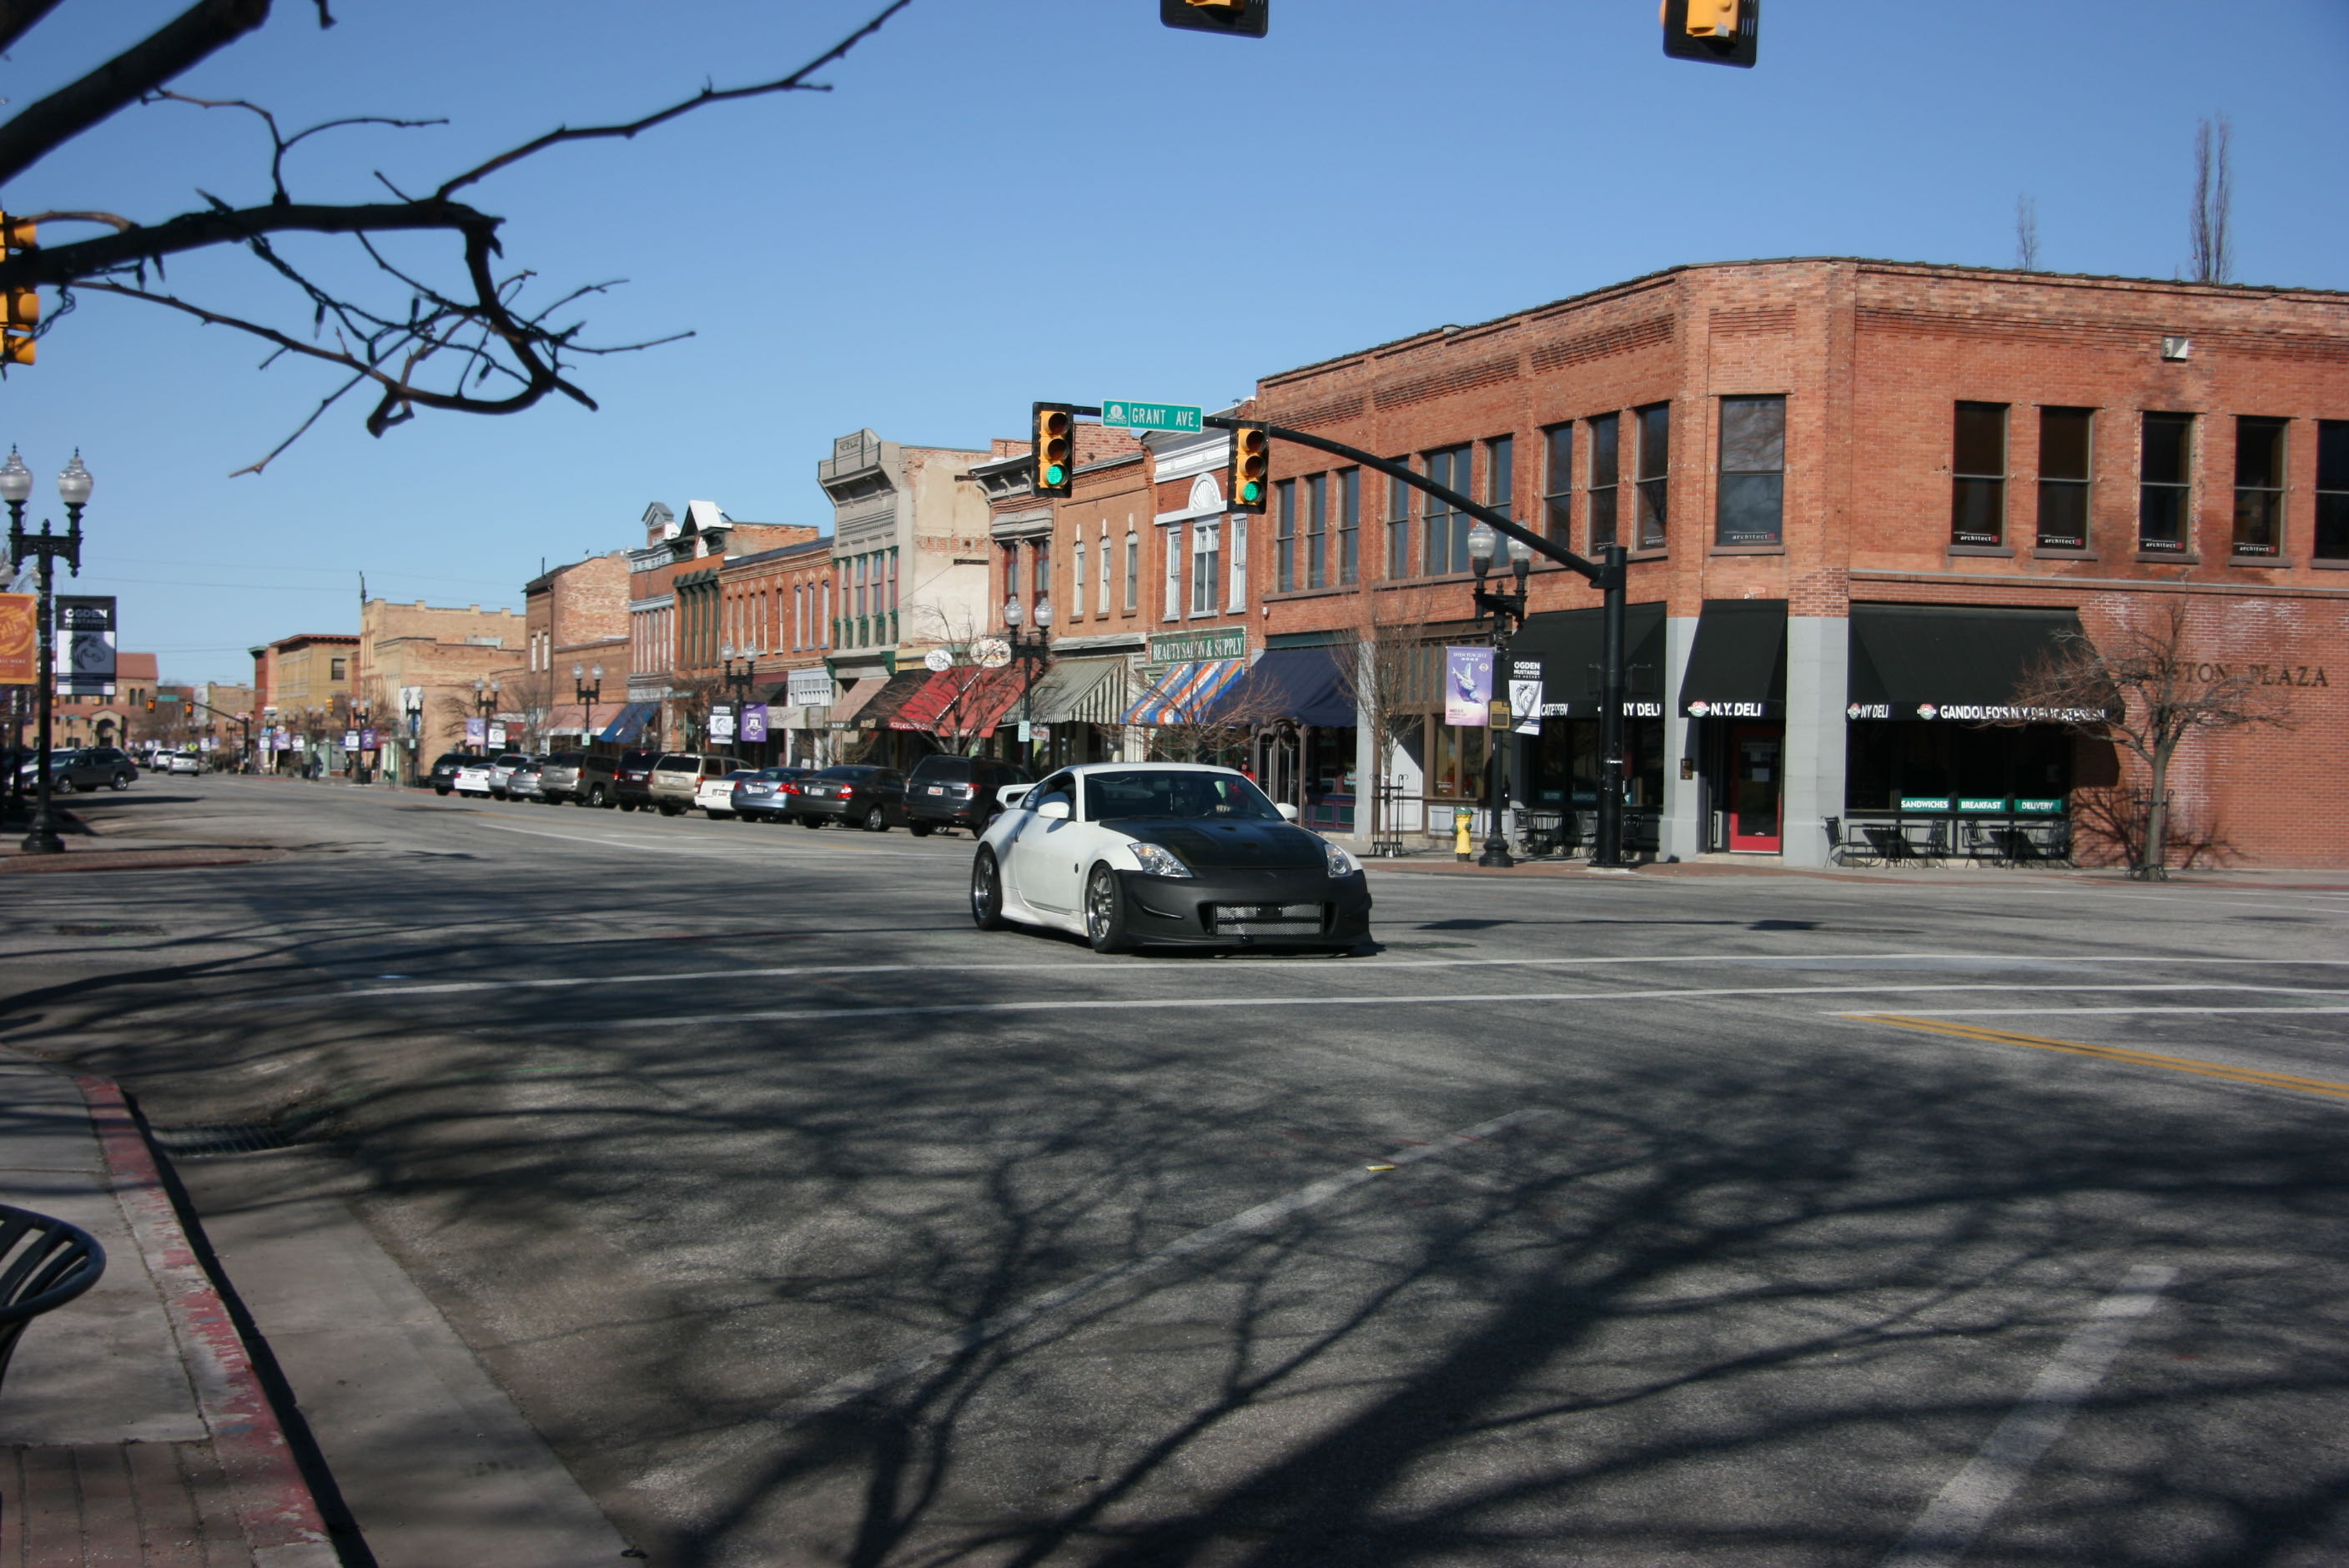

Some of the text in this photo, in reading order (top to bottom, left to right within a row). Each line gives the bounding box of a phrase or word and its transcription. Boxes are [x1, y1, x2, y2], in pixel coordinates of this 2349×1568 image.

[1132, 407, 1200, 428] GRANT AVE.
[65, 608, 108, 618] OGDEN
[1153, 643, 1180, 661] BEAUTY
[1206, 640, 1212, 658] &
[1214, 637, 1243, 656] SUPPLY
[1513, 661, 1541, 670] OGDEN
[2249, 664, 2329, 687] PLAZA
[1637, 703, 1661, 716] DELI
[1711, 703, 1761, 717] N.Y. DELI
[1873, 704, 1889, 718] DELI
[1939, 705, 2009, 720] GANDOLFO'S
